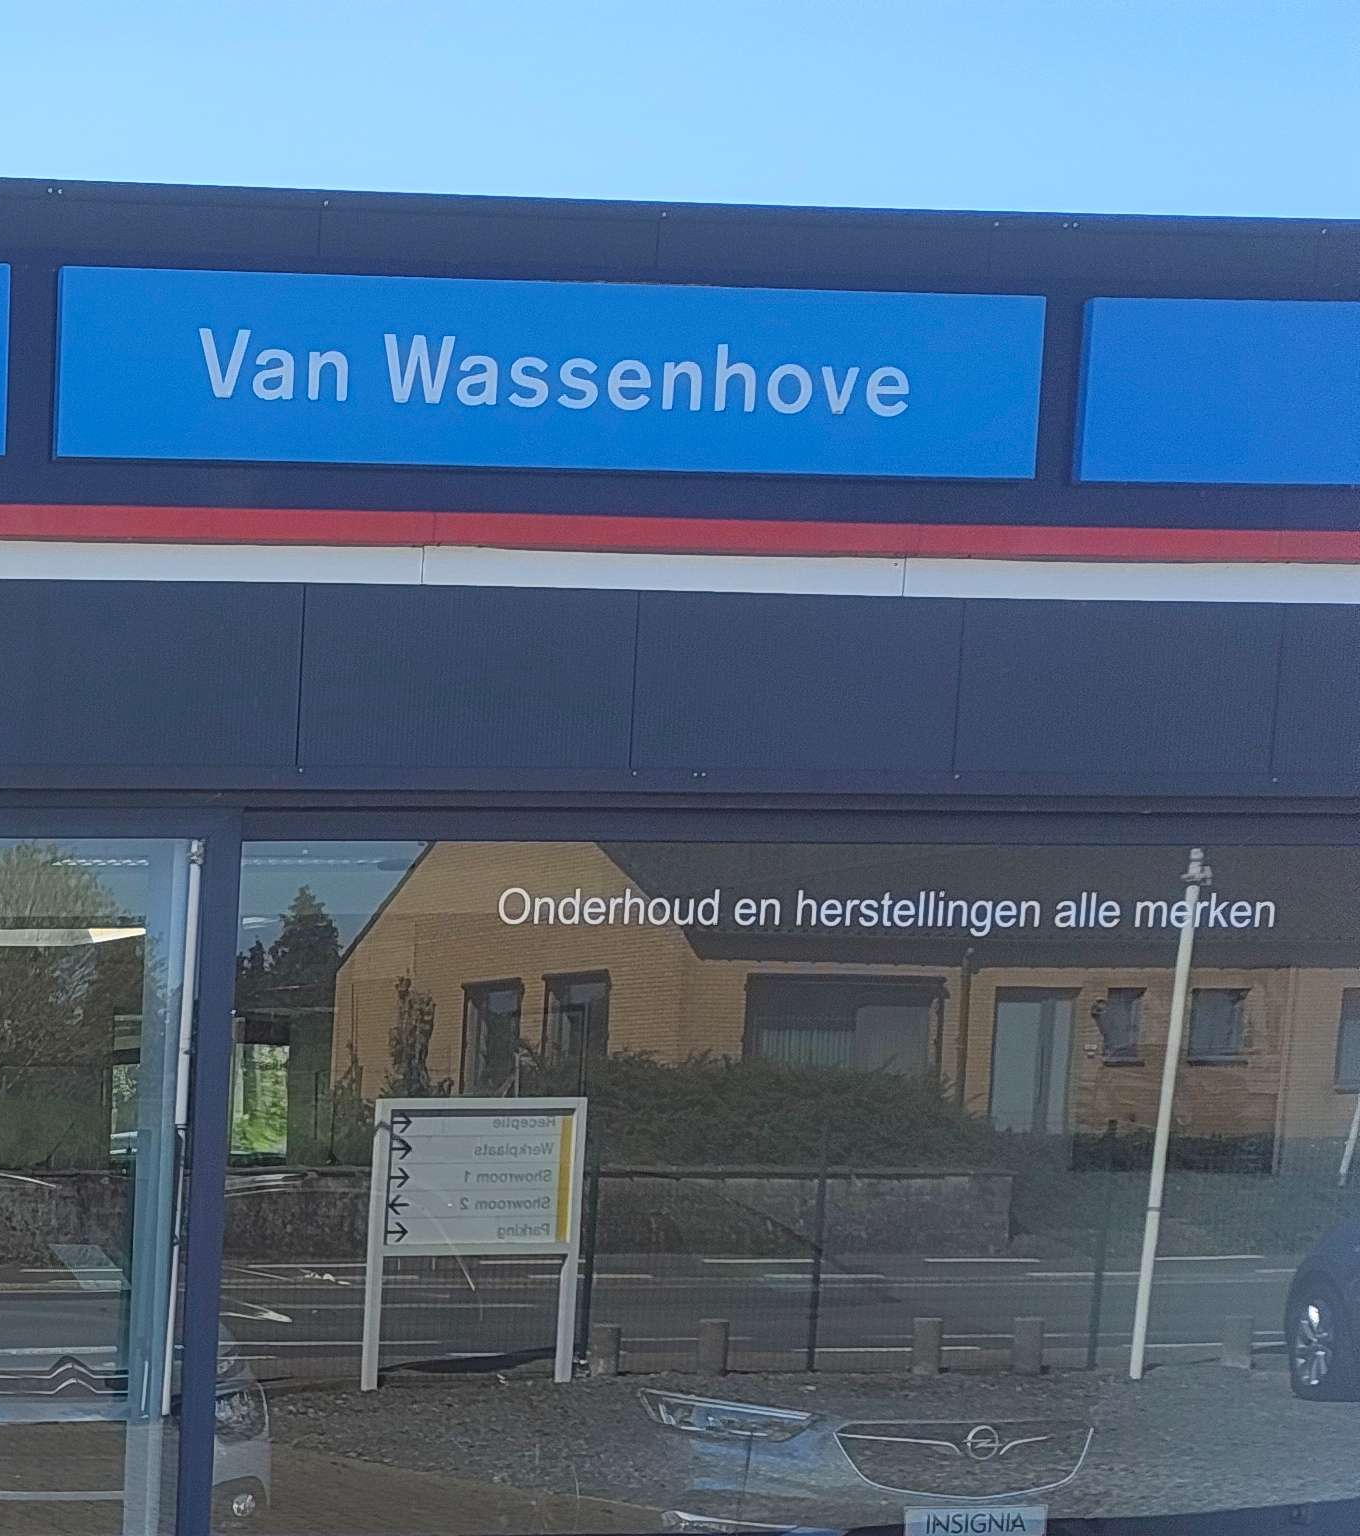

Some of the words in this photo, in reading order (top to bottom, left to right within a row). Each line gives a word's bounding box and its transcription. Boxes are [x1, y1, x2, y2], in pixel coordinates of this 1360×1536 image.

[198, 327, 349, 404] Van
[383, 332, 911, 418] Wassenhove
[497, 887, 720, 926] Onderhoud
[733, 897, 781, 926] en
[795, 889, 1041, 937] herstellingen
[1054, 891, 1121, 928] alle
[1135, 892, 1277, 929] merken
[926, 1513, 1026, 1534] INSIGNIA
